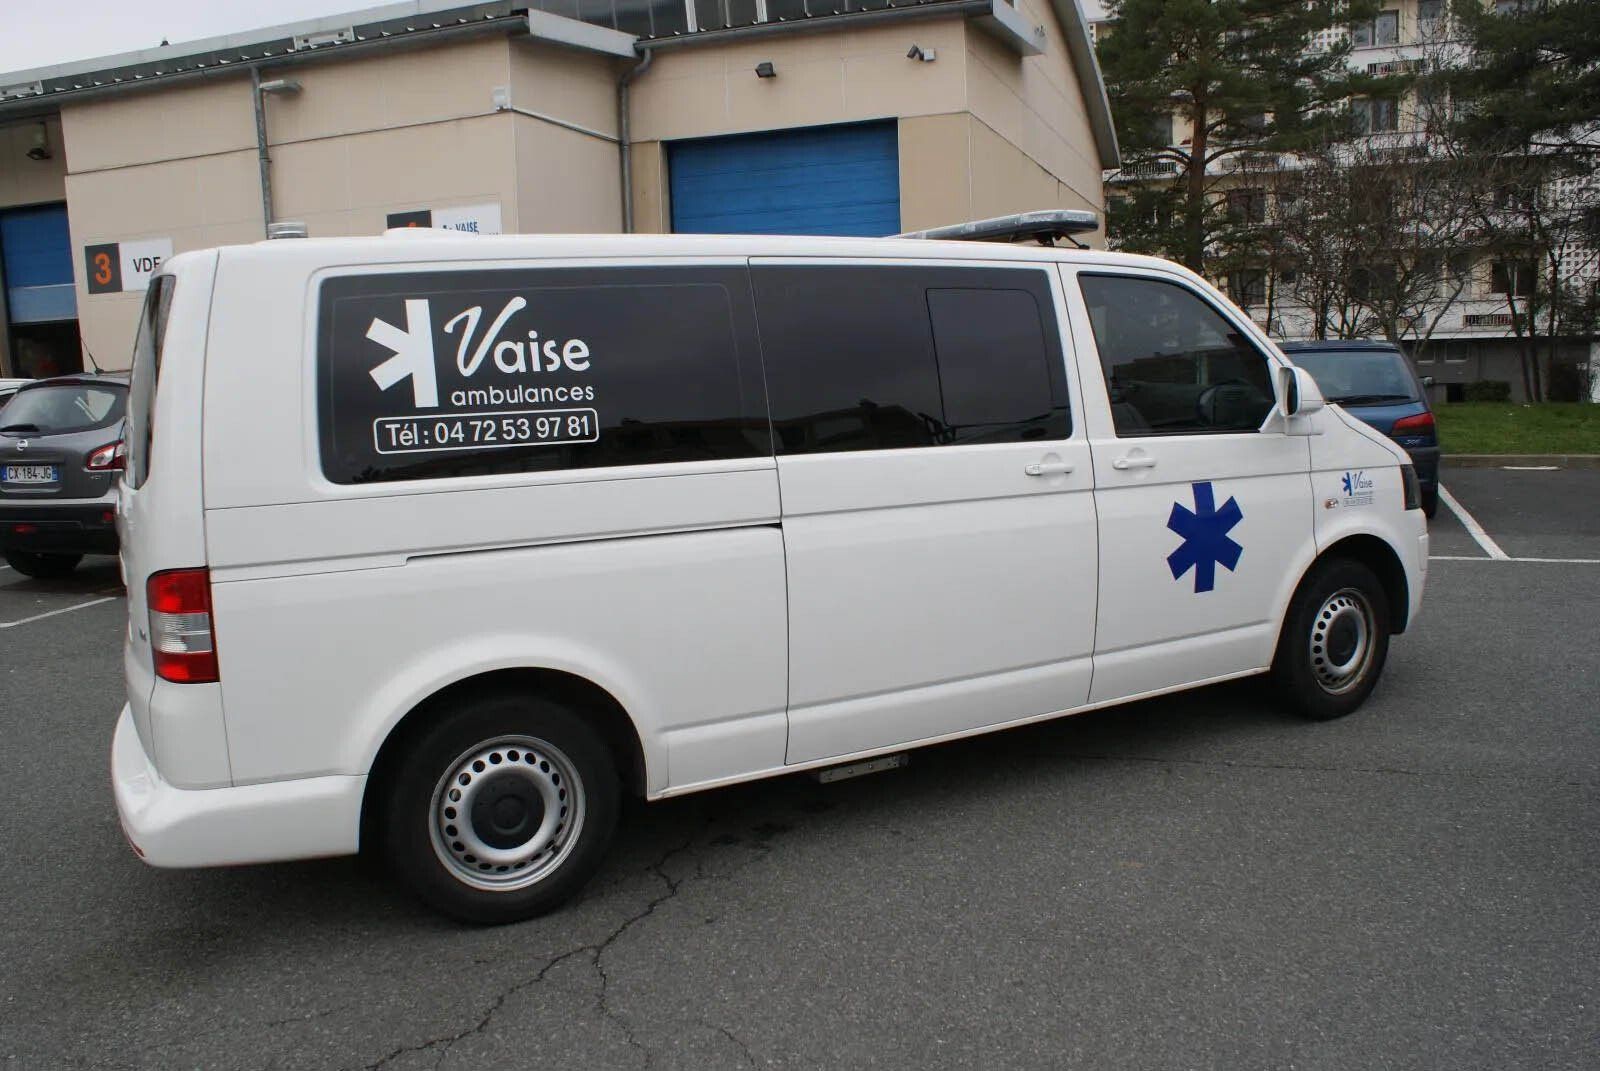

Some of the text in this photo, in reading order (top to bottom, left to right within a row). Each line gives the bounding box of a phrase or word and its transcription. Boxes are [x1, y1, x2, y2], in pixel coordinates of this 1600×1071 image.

[455, 221, 478, 232] VAISE
[95, 253, 112, 285] 3
[443, 296, 591, 377] Vaise
[451, 384, 595, 407] ambulances
[434, 421, 465, 444] 04
[469, 420, 497, 443] 72
[502, 418, 531, 441] 53
[535, 416, 562, 439] 97
[567, 415, 589, 437] 81
[1351, 471, 1373, 489] Vaise
